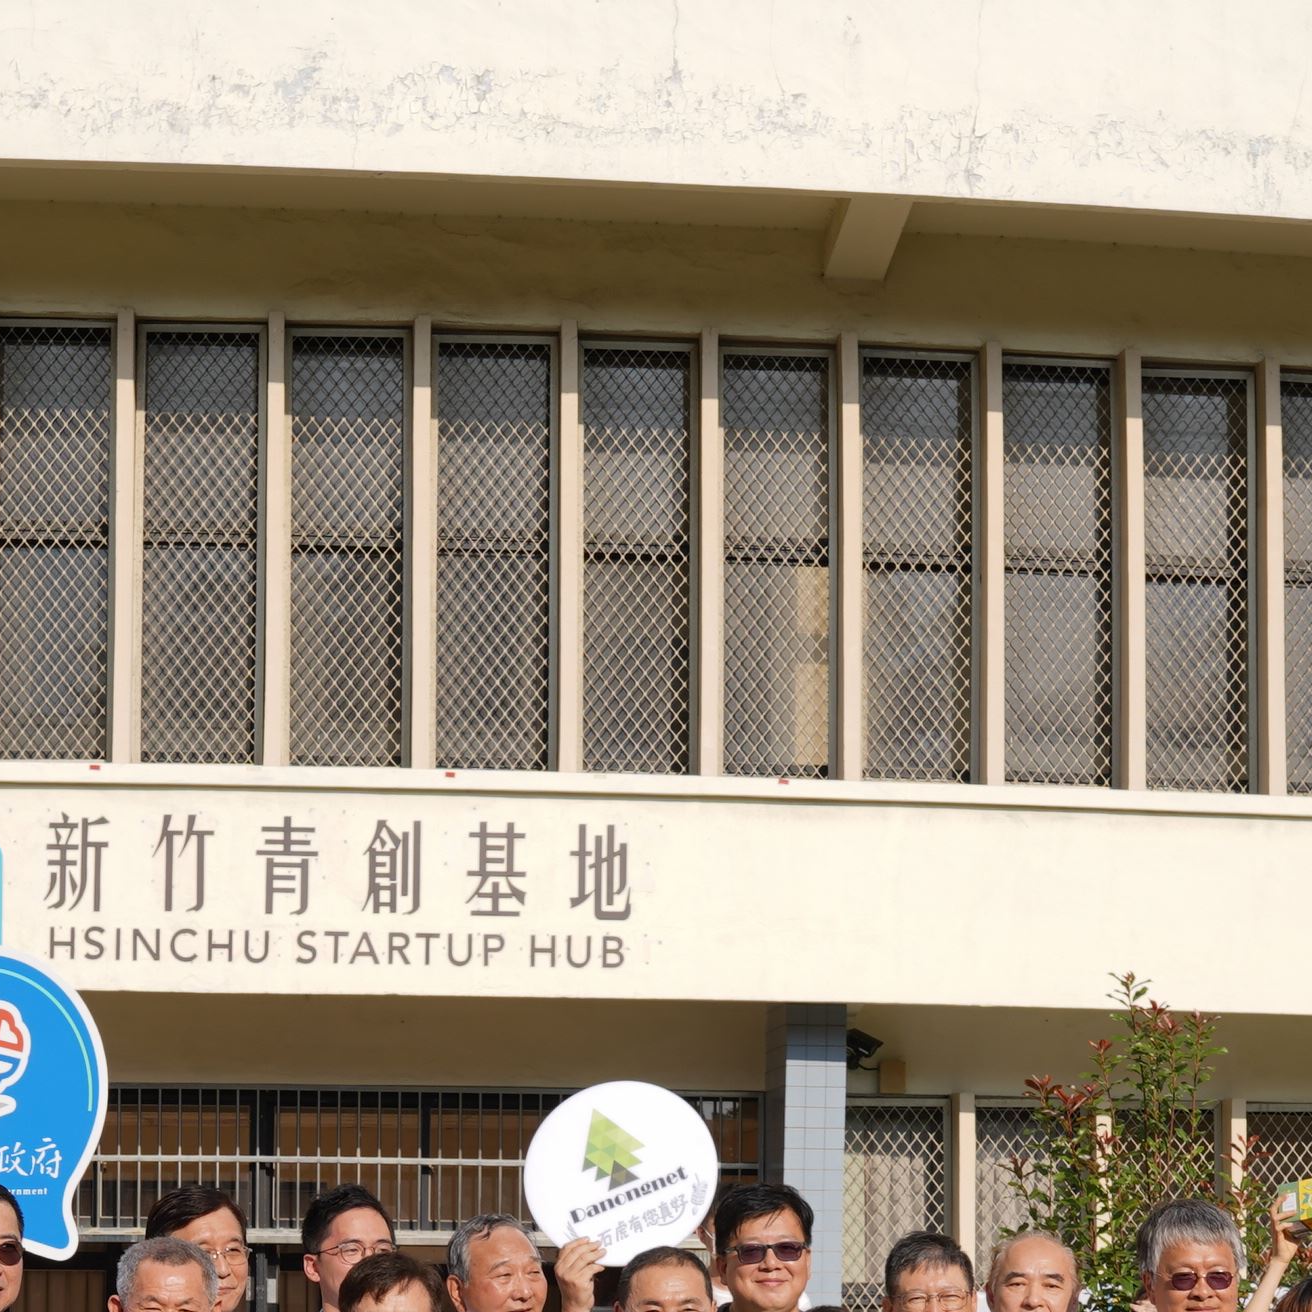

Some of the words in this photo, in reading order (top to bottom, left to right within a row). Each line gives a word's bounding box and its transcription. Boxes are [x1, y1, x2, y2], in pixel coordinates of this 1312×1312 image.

[44, 811, 632, 921] 新竹青創基地
[48, 926, 271, 963] HSINCHU
[295, 930, 506, 967] STARTUP
[529, 934, 626, 969] HUB
[569, 1165, 689, 1225] Danongnet
